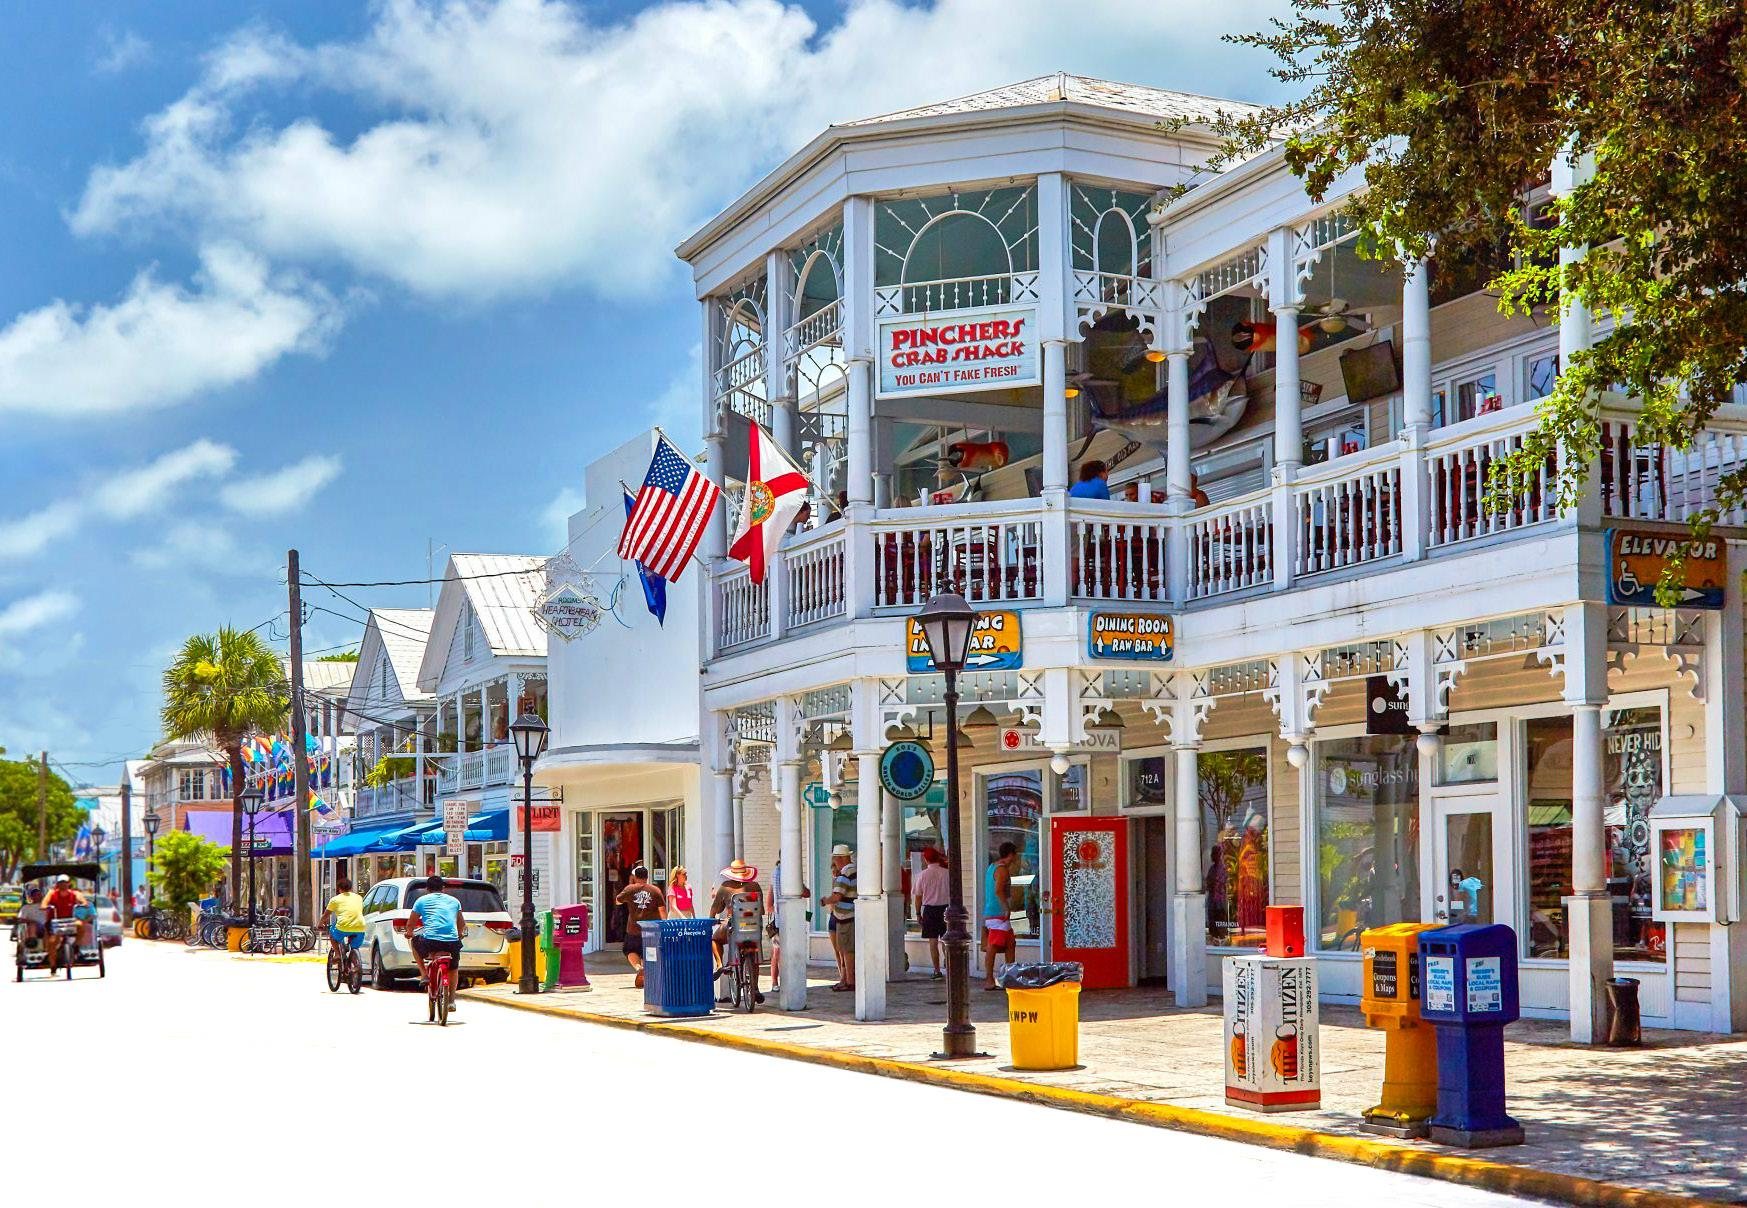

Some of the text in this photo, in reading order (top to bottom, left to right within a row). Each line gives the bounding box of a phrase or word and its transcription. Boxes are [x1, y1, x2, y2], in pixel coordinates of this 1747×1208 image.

[891, 318, 1025, 350] PINCHERS
[891, 341, 1026, 368] CRAB SHACK
[895, 366, 1017, 386] YOU CAN'T FAKE FRESH
[542, 604, 598, 617] HEARTBREAK
[1096, 616, 1169, 634] DINING ROOM
[1111, 638, 1153, 653] RAW BAR
[1022, 733, 1117, 747] TEOVA
[1607, 734, 1642, 755] NEVER
[1350, 765, 1404, 790] sunglass
[532, 807, 560, 819] LIRT
[1373, 972, 1396, 983] Coupons
[1380, 983, 1395, 994] Maps
[1233, 966, 1247, 1082] THE CITIZEN
[1276, 967, 1298, 1085] THE CITIZEN
